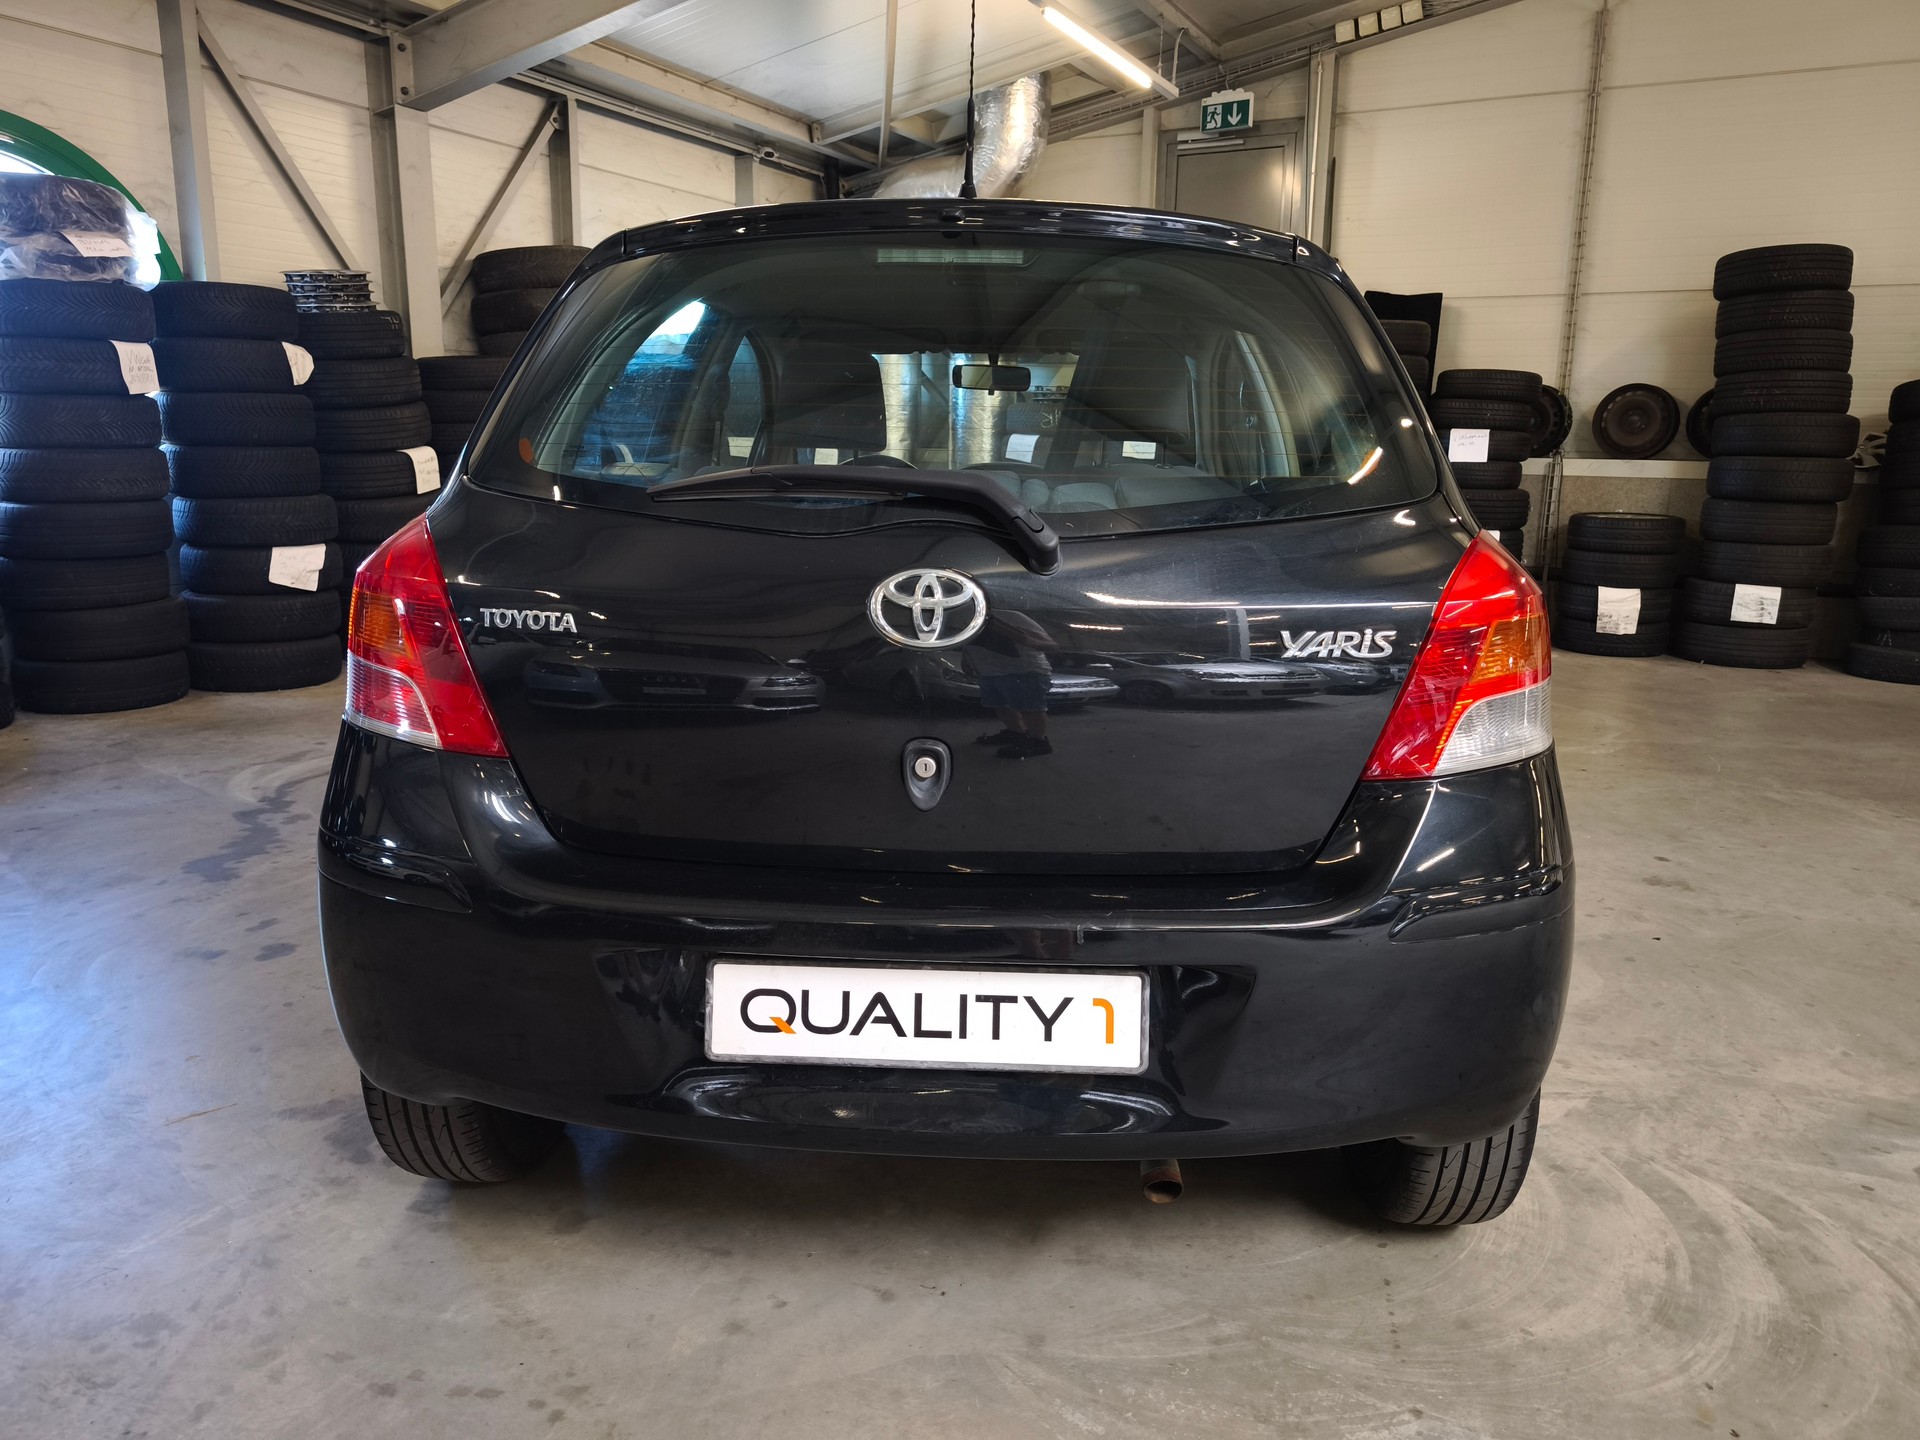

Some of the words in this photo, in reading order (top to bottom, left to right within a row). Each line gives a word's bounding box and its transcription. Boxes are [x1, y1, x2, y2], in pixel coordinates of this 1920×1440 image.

[480, 607, 578, 633] TOYOTA
[740, 988, 1074, 1042] QUALITY
[1093, 998, 1114, 1044] 1
